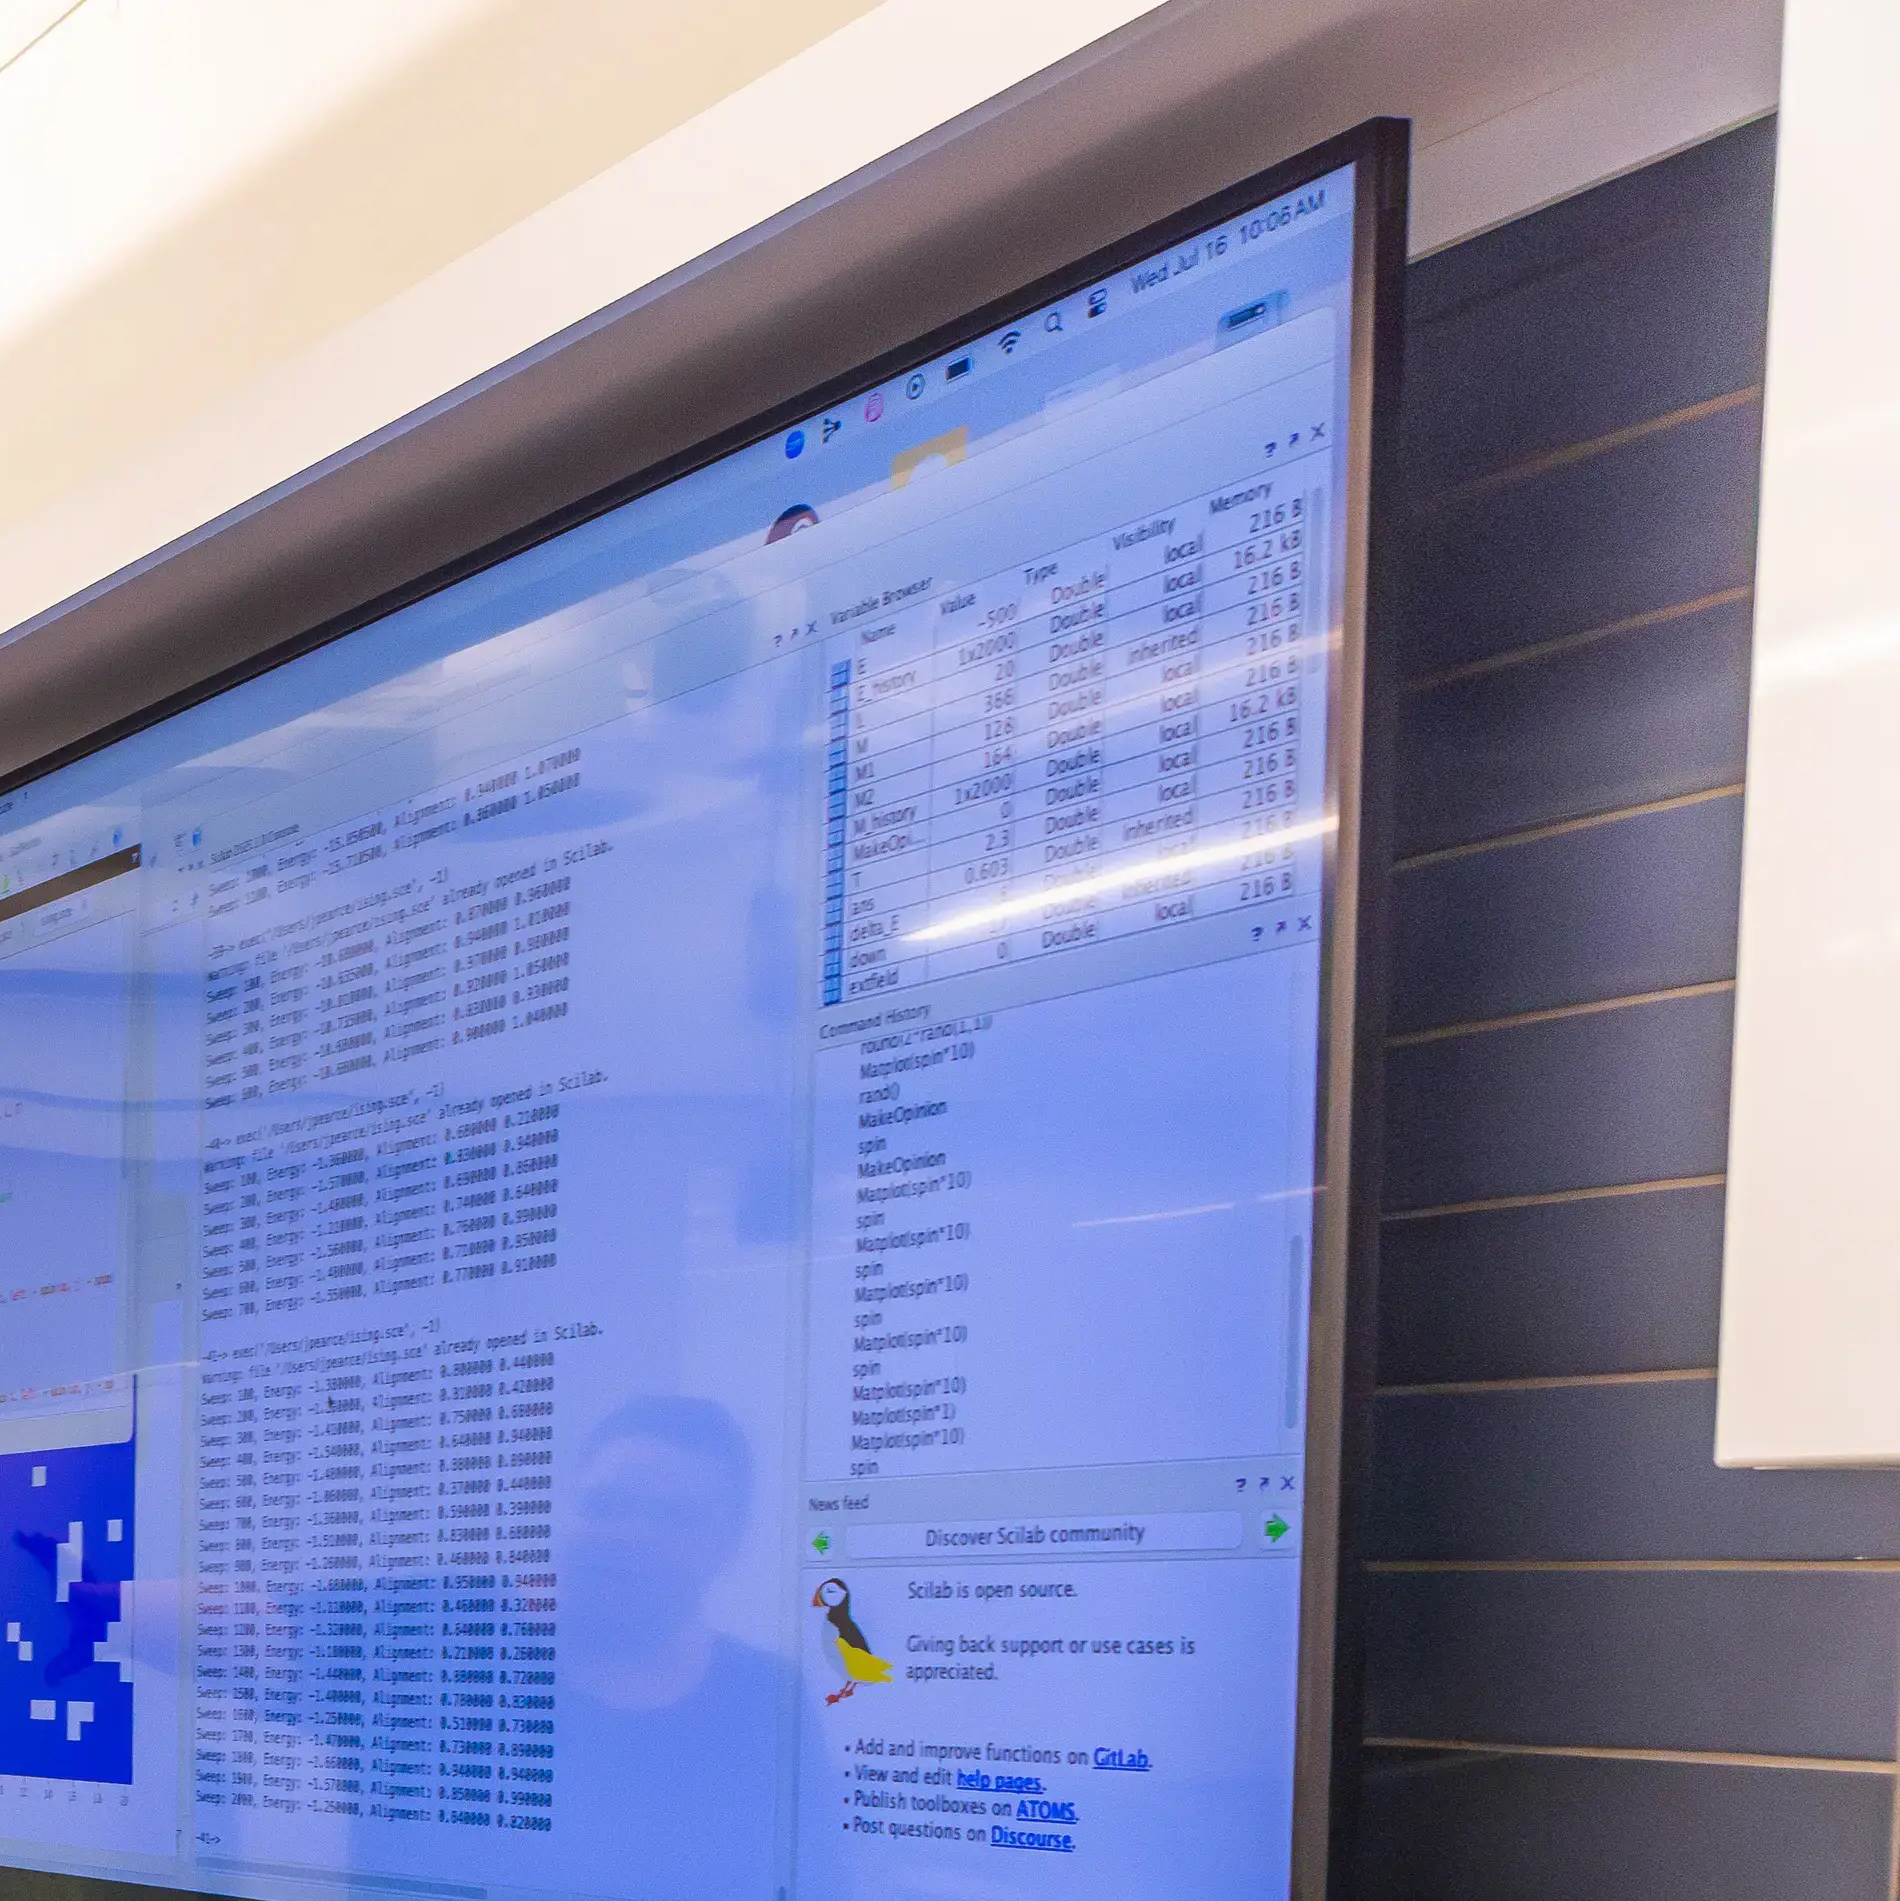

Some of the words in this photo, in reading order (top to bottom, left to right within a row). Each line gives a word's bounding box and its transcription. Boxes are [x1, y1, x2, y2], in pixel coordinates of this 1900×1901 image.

[1132, 266, 1168, 294] Wed
[1206, 234, 1229, 261] 16
[939, 587, 977, 616] Value
[1023, 559, 1057, 587] Type
[1112, 514, 1175, 552] Visibility
[1210, 477, 1273, 515] Memory
[1050, 569, 1106, 606] Double
[1164, 532, 1202, 565] local
[1248, 501, 1286, 534] 216
[830, 592, 879, 625] Variable
[881, 574, 934, 607] Browser
[1049, 598, 1105, 634] Double
[1163, 562, 1201, 594] local
[1232, 537, 1273, 570] 16.2
[1049, 627, 1104, 663] Double
[1163, 592, 1200, 624] local
[1246, 564, 1284, 595] 216
[1048, 657, 1103, 691] Double
[1246, 595, 1283, 626] 216
[1046, 744, 1101, 777] Double
[1160, 713, 1196, 743] local
[1228, 691, 1269, 723] 16.2
[1045, 773, 1100, 806] Double
[1159, 744, 1196, 773] local
[1242, 719, 1280, 749] 216
[1045, 803, 1099, 834] Double
[1158, 774, 1195, 803] local
[1241, 750, 1279, 779] 216
[1044, 832, 1098, 863] Double
[1241, 781, 1278, 810] 216
[1042, 919, 1096, 949] Double
[1156, 895, 1191, 922] local
[1238, 874, 1276, 902] 216
[819, 1011, 882, 1041] Command
[885, 1001, 931, 1026] History
[858, 1098, 946, 1130] MakeOpinion
[858, 1135, 886, 1157] spin
[857, 1149, 945, 1179] MakeOpinion
[856, 1210, 884, 1231] spin
[855, 1260, 883, 1281] spin
[853, 1309, 882, 1330] spin
[852, 1359, 881, 1379] spin
[850, 1458, 878, 1477] spin
[808, 1497, 839, 1511] News
[842, 1495, 868, 1510] feed
[926, 1528, 992, 1547] Discover
[996, 1526, 1044, 1545] Scilab
[1050, 1522, 1144, 1545] community
[908, 1582, 952, 1599] Scilab
[956, 1583, 969, 1598] is
[974, 1585, 1013, 1600] open
[1018, 1583, 1077, 1598] source.
[906, 1635, 953, 1655] Giving
[959, 1636, 993, 1653] back
[1001, 1637, 1063, 1658] support
[1069, 1640, 1086, 1653] or
[1092, 1640, 1120, 1654] use
[1127, 1639, 1174, 1655] cases
[1179, 1638, 1195, 1655] is
[906, 1662, 998, 1684] appreciated.
[371, 1713, 432, 1733] Alignment:
[854, 1737, 883, 1755] Add
[888, 1740, 914, 1757] and
[918, 1741, 981, 1764] improve
[986, 1744, 1060, 1765] functions
[1066, 1751, 1088, 1766] on
[1092, 1746, 1153, 1772] GitLab.
[854, 1764, 887, 1782] View
[892, 1767, 918, 1785] and
[923, 1768, 952, 1786] edit
[956, 1770, 990, 1791] help
[994, 1774, 1047, 1795] pages.
[854, 1788, 906, 1810] Publish
[910, 1793, 986, 1816] toolboxes
[990, 1803, 1011, 1817] on
[1016, 1798, 1079, 1825] ATOMS.
[853, 1816, 884, 1835] Post
[888, 1819, 960, 1844] questions
[966, 1827, 985, 1843] on
[990, 1825, 1076, 1853] Discourse.
